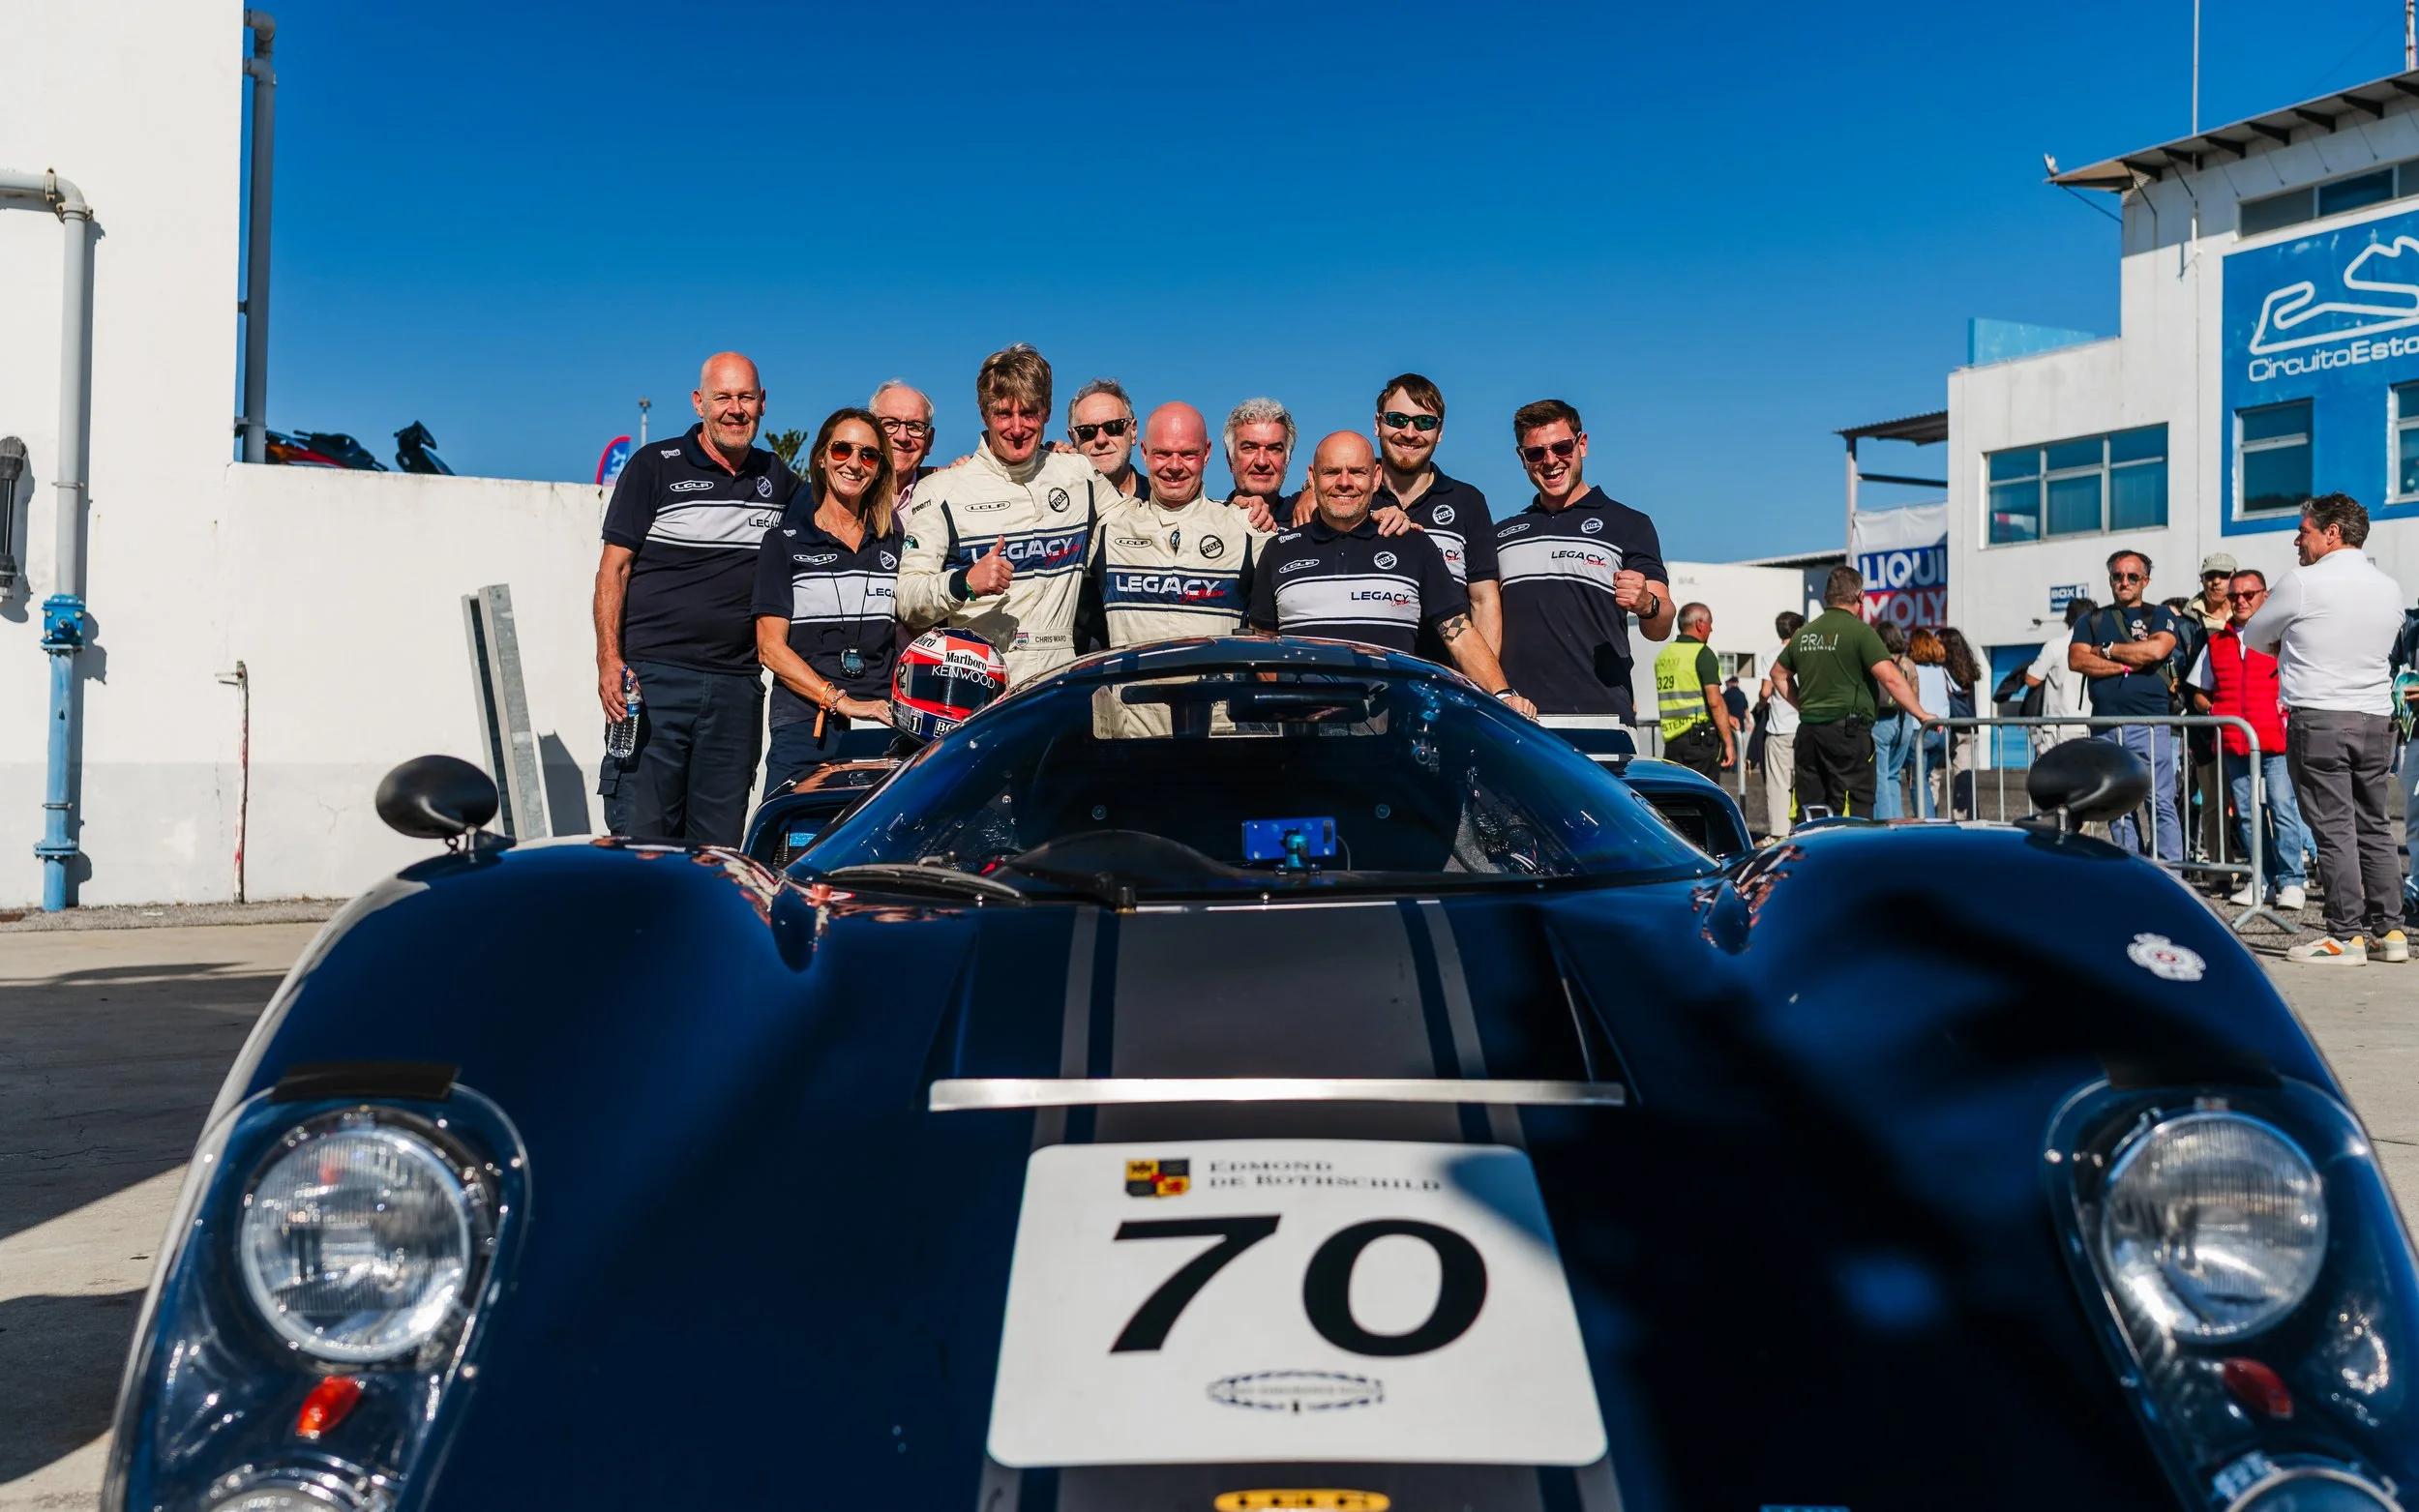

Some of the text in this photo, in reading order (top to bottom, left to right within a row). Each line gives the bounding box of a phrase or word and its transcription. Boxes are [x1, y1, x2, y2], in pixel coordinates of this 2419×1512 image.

[1052, 491, 1067, 509] TIGA
[1434, 510, 1452, 520] TIGA
[1583, 520, 1601, 530] TIGA
[1201, 542, 1223, 553] TIGA
[1377, 554, 1394, 566] TIGA
[1551, 550, 1604, 564] LEGACY
[1861, 548, 1946, 590] LIQUI
[1116, 575, 1220, 597] LEGACY
[2051, 587, 2075, 599] BOX
[1351, 591, 1409, 604] LEGACY
[1862, 590, 1947, 629] MOLY
[1054, 635, 1066, 643] WARD
[945, 651, 987, 671] Marlboro
[932, 665, 996, 690] KENWOOD
[1657, 675, 1675, 691] 329
[911, 717, 919, 731] 1
[1210, 1161, 1332, 1173] EDMOND
[1210, 1174, 1441, 1191] DE ROTHSCHILD
[1109, 1213, 1489, 1358] 70
